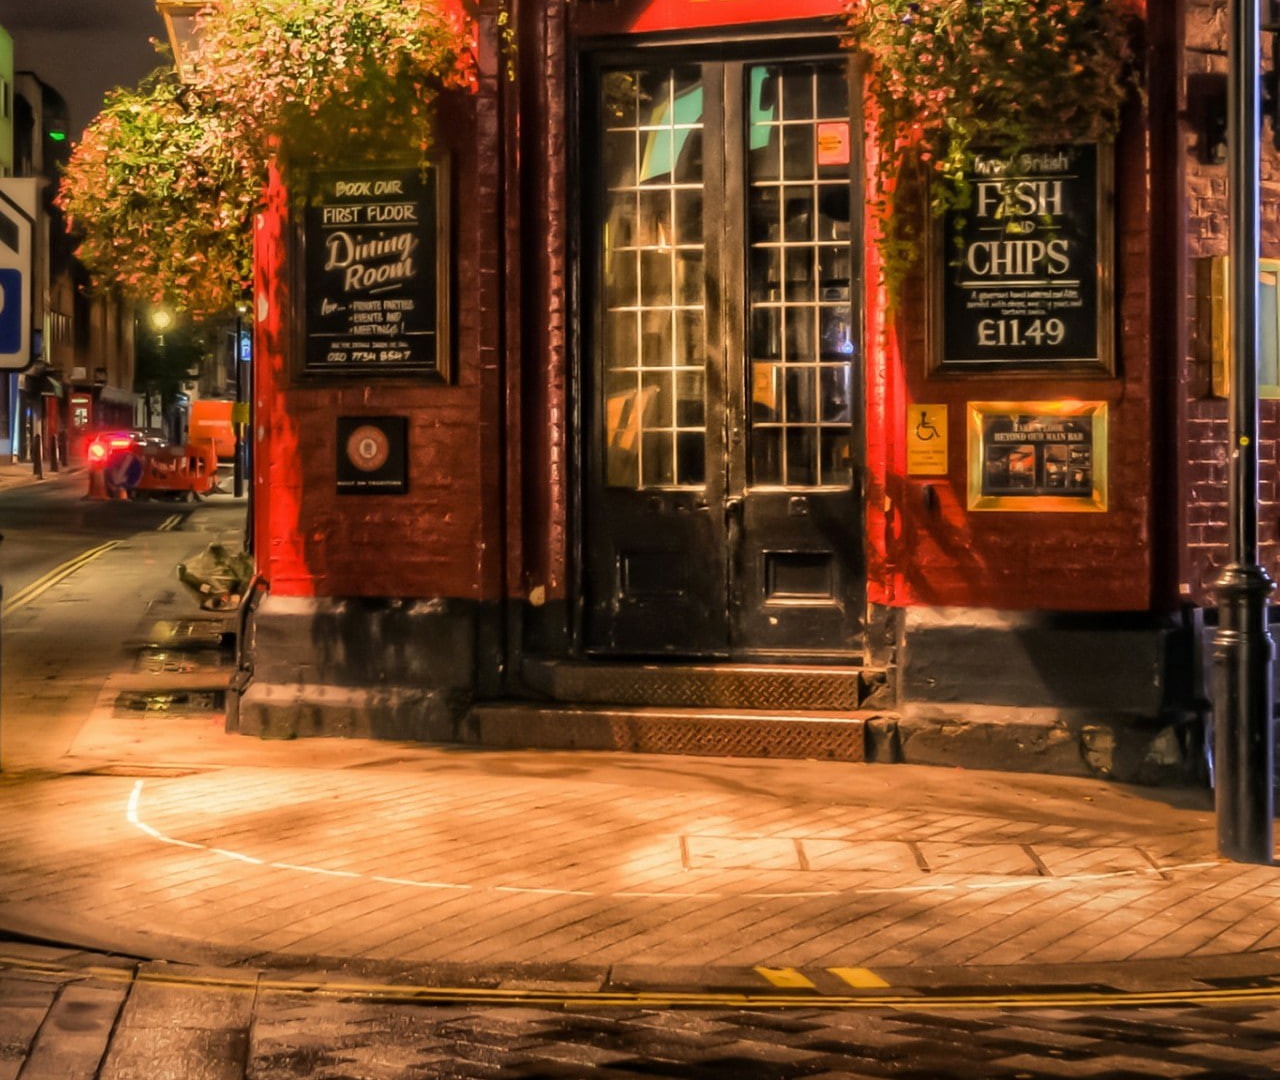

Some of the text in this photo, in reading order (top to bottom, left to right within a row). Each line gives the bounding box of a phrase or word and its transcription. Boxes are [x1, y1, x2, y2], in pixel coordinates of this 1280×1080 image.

[335, 180, 404, 197] BOOK OUR
[323, 205, 418, 223] FIRST FLOOR
[324, 231, 419, 271] Dining
[967, 240, 1070, 276] CHIPS
[344, 257, 417, 291] Room
[977, 318, 1065, 346] £11.49
